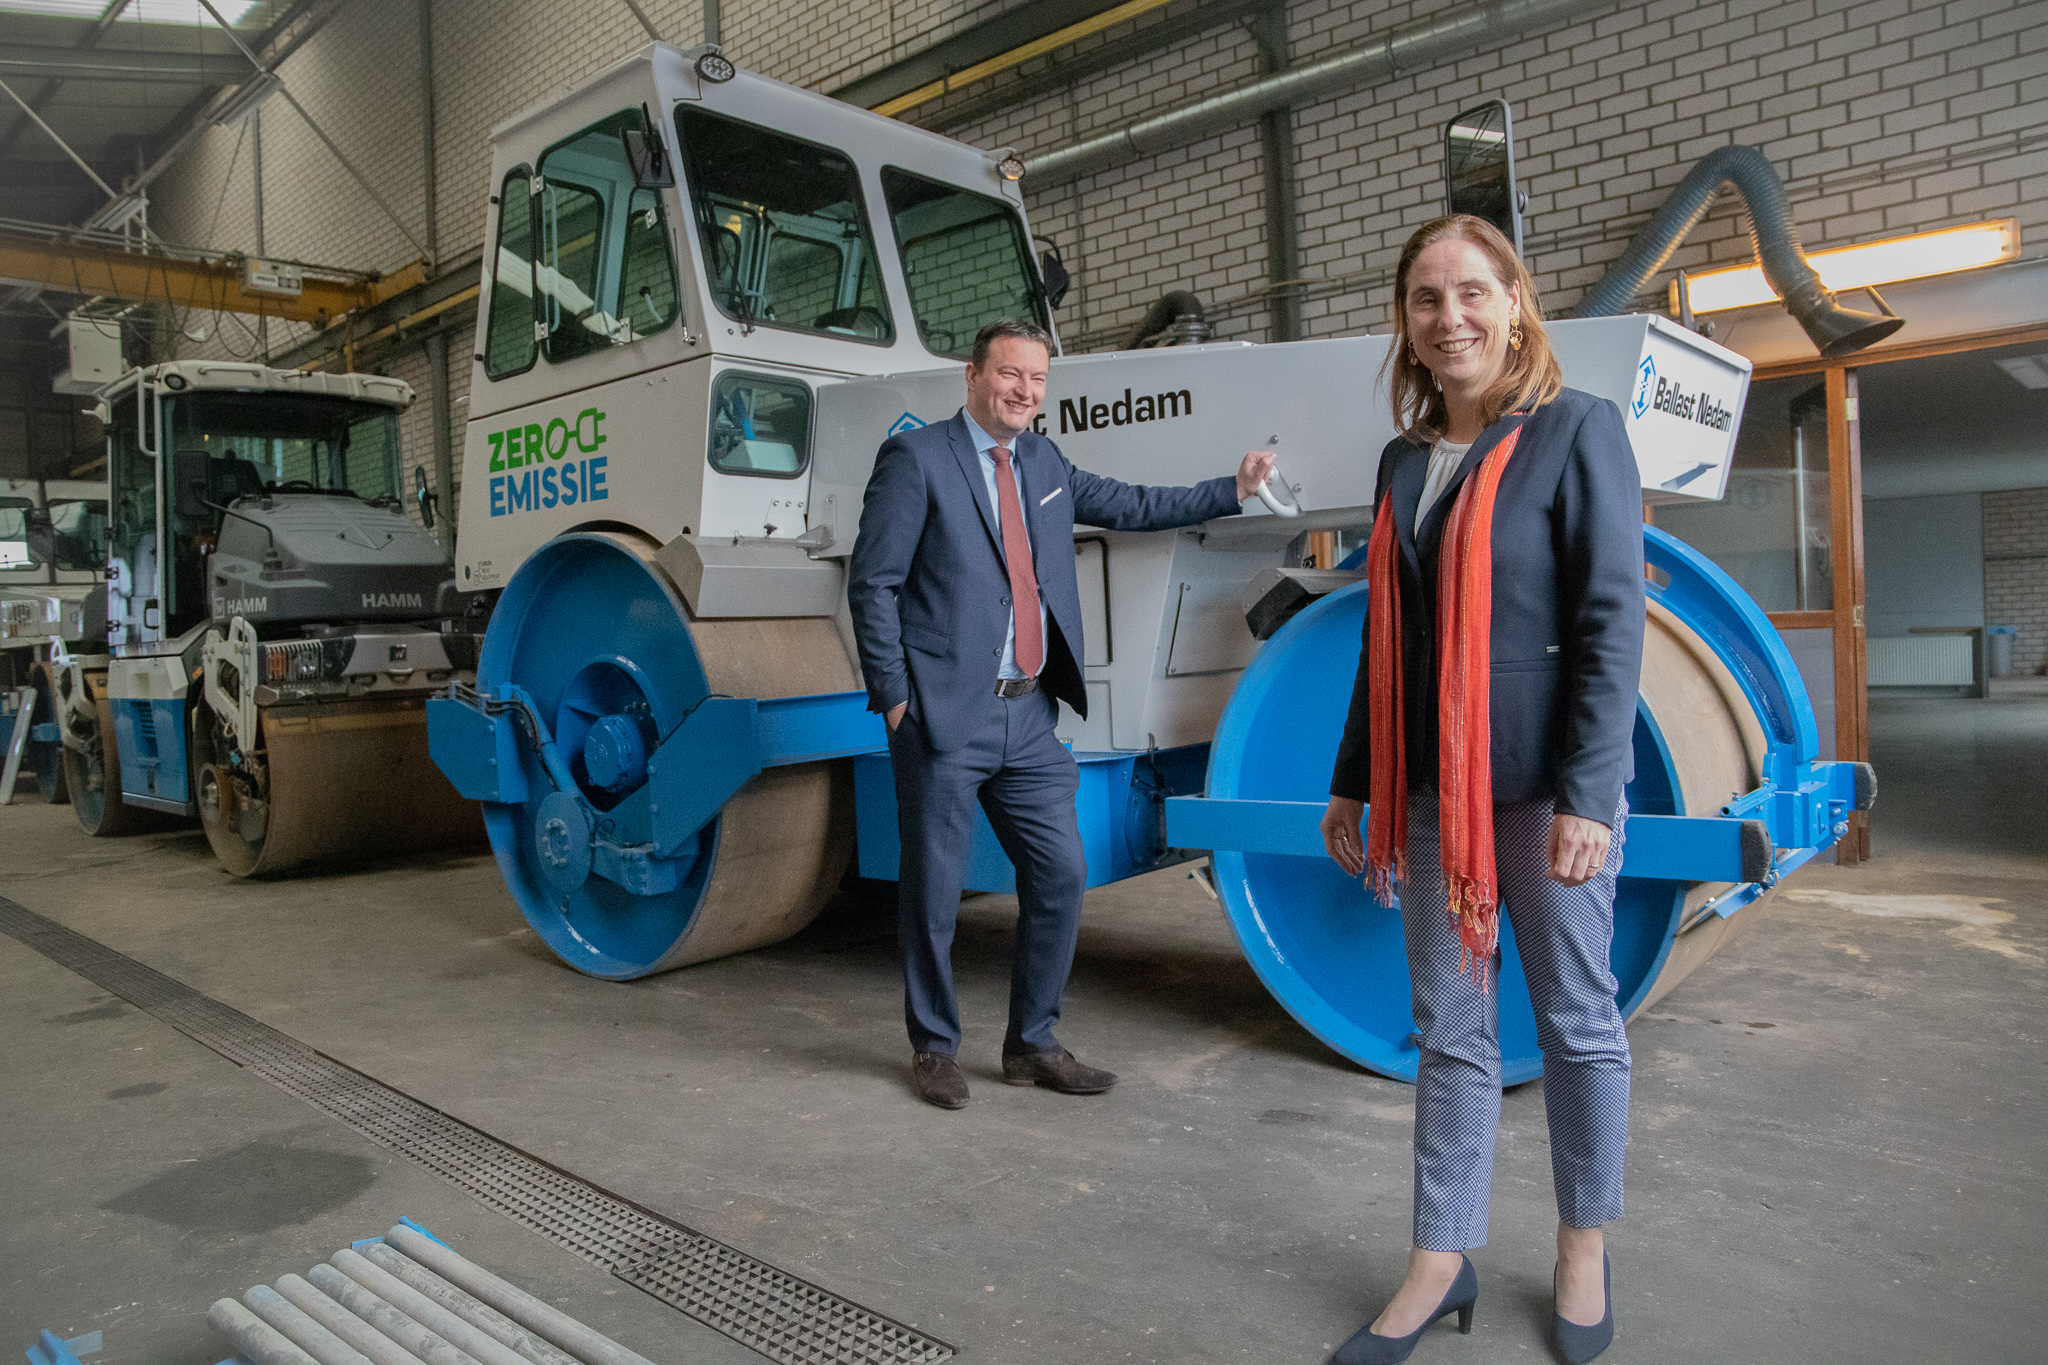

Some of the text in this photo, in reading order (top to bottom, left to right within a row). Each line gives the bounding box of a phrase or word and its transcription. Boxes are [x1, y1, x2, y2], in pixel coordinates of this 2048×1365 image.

[1059, 388, 1192, 434] Nedam
[1653, 376, 1732, 432] Ballast Nedam
[488, 417, 570, 473] ZERO
[490, 456, 609, 517] EMISSIE
[227, 597, 267, 614] HAMM
[362, 593, 422, 608] HAMM
